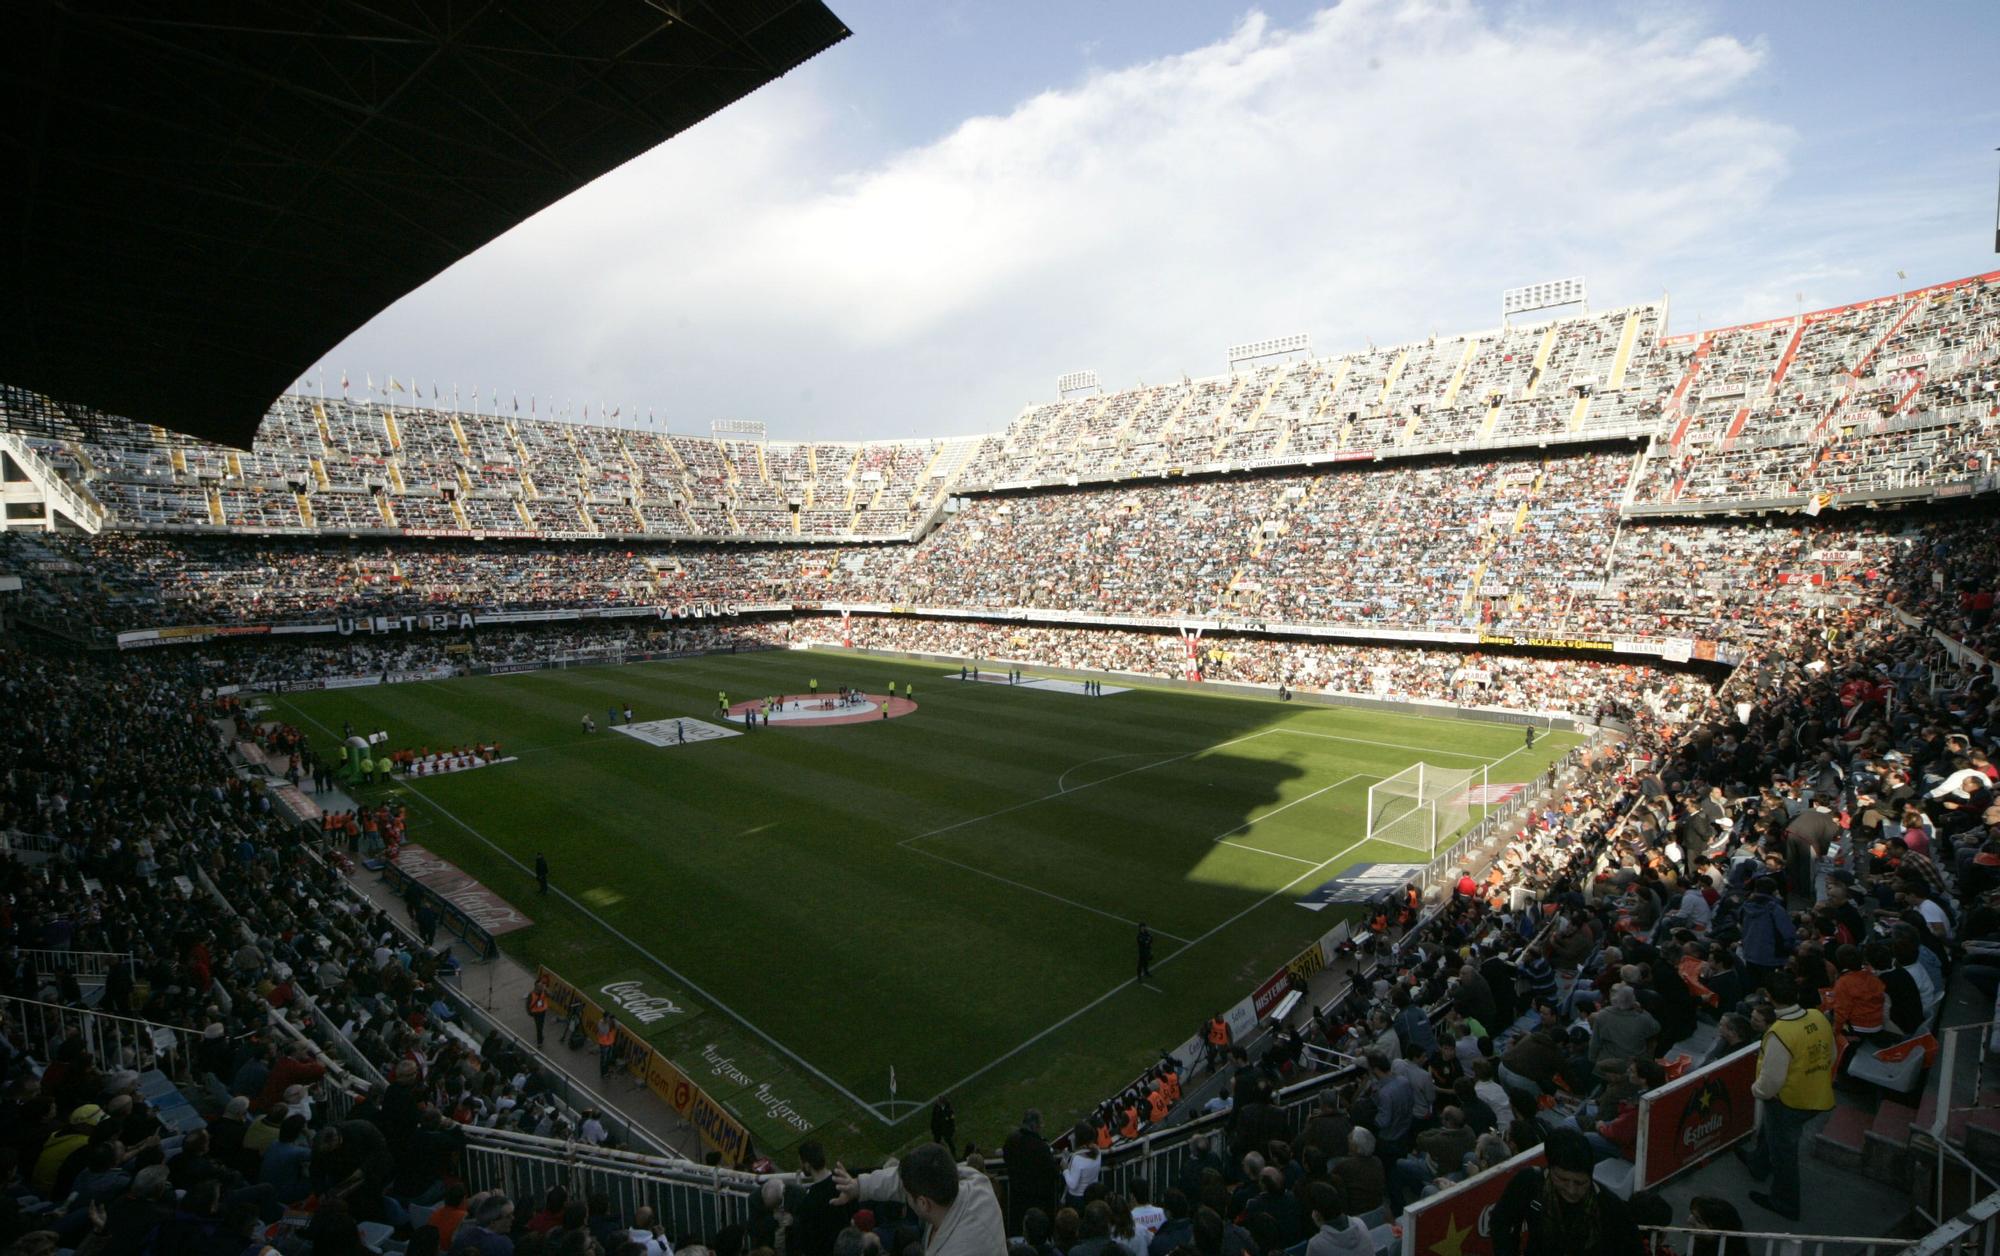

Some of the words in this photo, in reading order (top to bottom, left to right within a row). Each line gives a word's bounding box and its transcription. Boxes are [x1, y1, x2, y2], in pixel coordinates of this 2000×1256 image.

[1897, 354, 1926, 365] MARCA
[1714, 384, 1740, 393] MARCA
[1691, 432, 1713, 440] MARC
[1821, 552, 1849, 560] MARCA
[1528, 638, 1567, 647] ROLEX
[1464, 671, 1488, 680] MARCA
[702, 1043, 754, 1088] turfgrass
[755, 1083, 815, 1132] turfgrass
[1683, 1112, 1723, 1146] Estrella
